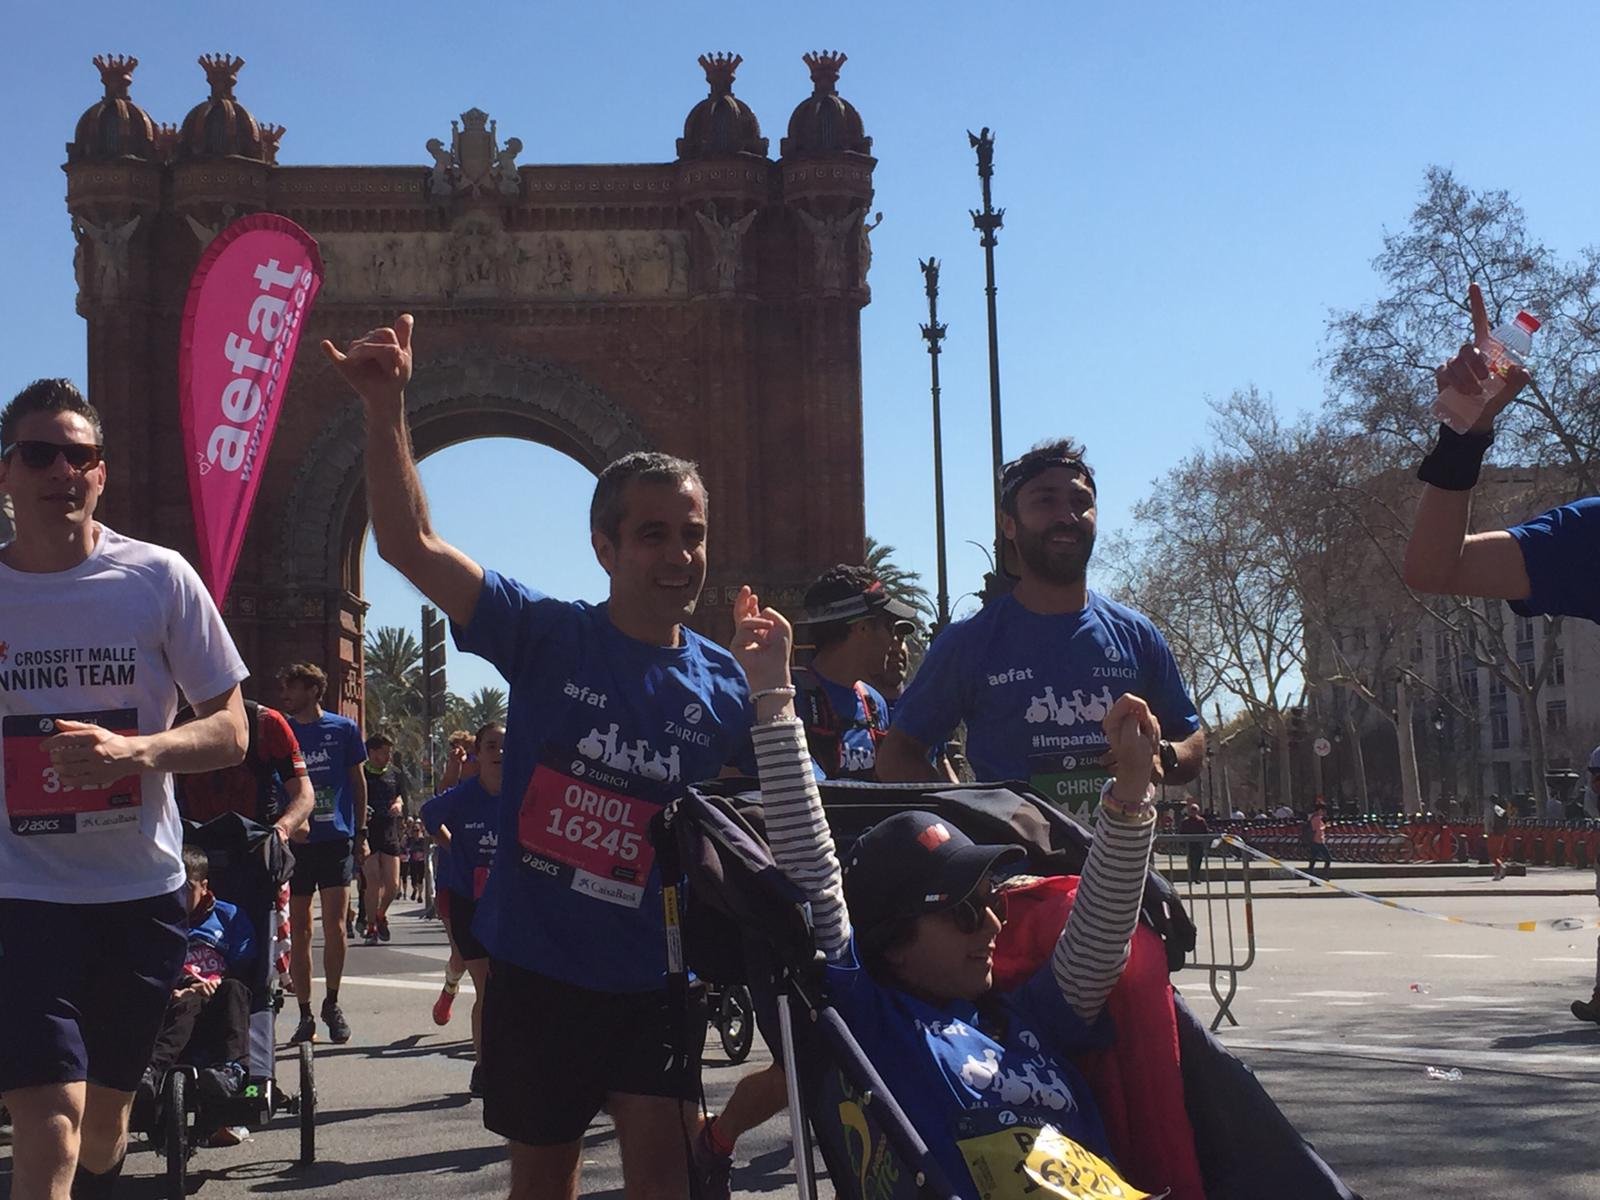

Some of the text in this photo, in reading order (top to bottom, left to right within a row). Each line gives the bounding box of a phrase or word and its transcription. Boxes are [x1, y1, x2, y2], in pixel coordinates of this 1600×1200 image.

[207, 258, 302, 472] aefat
[14, 647, 136, 667] CROSSFIT MALLE
[75, 664, 136, 686] TEAM
[987, 666, 1034, 687] aefat
[1092, 666, 1137, 680] ZURICH
[563, 681, 608, 709] aefat
[664, 721, 712, 748] ZURICH
[588, 767, 629, 790] ZURICH
[1056, 777, 1105, 796] CHRIS
[564, 784, 636, 828] ORIOL
[29, 819, 60, 831] asics
[545, 807, 643, 862] 16245
[530, 857, 560, 877] asics
[591, 881, 637, 903] CaixaBank
